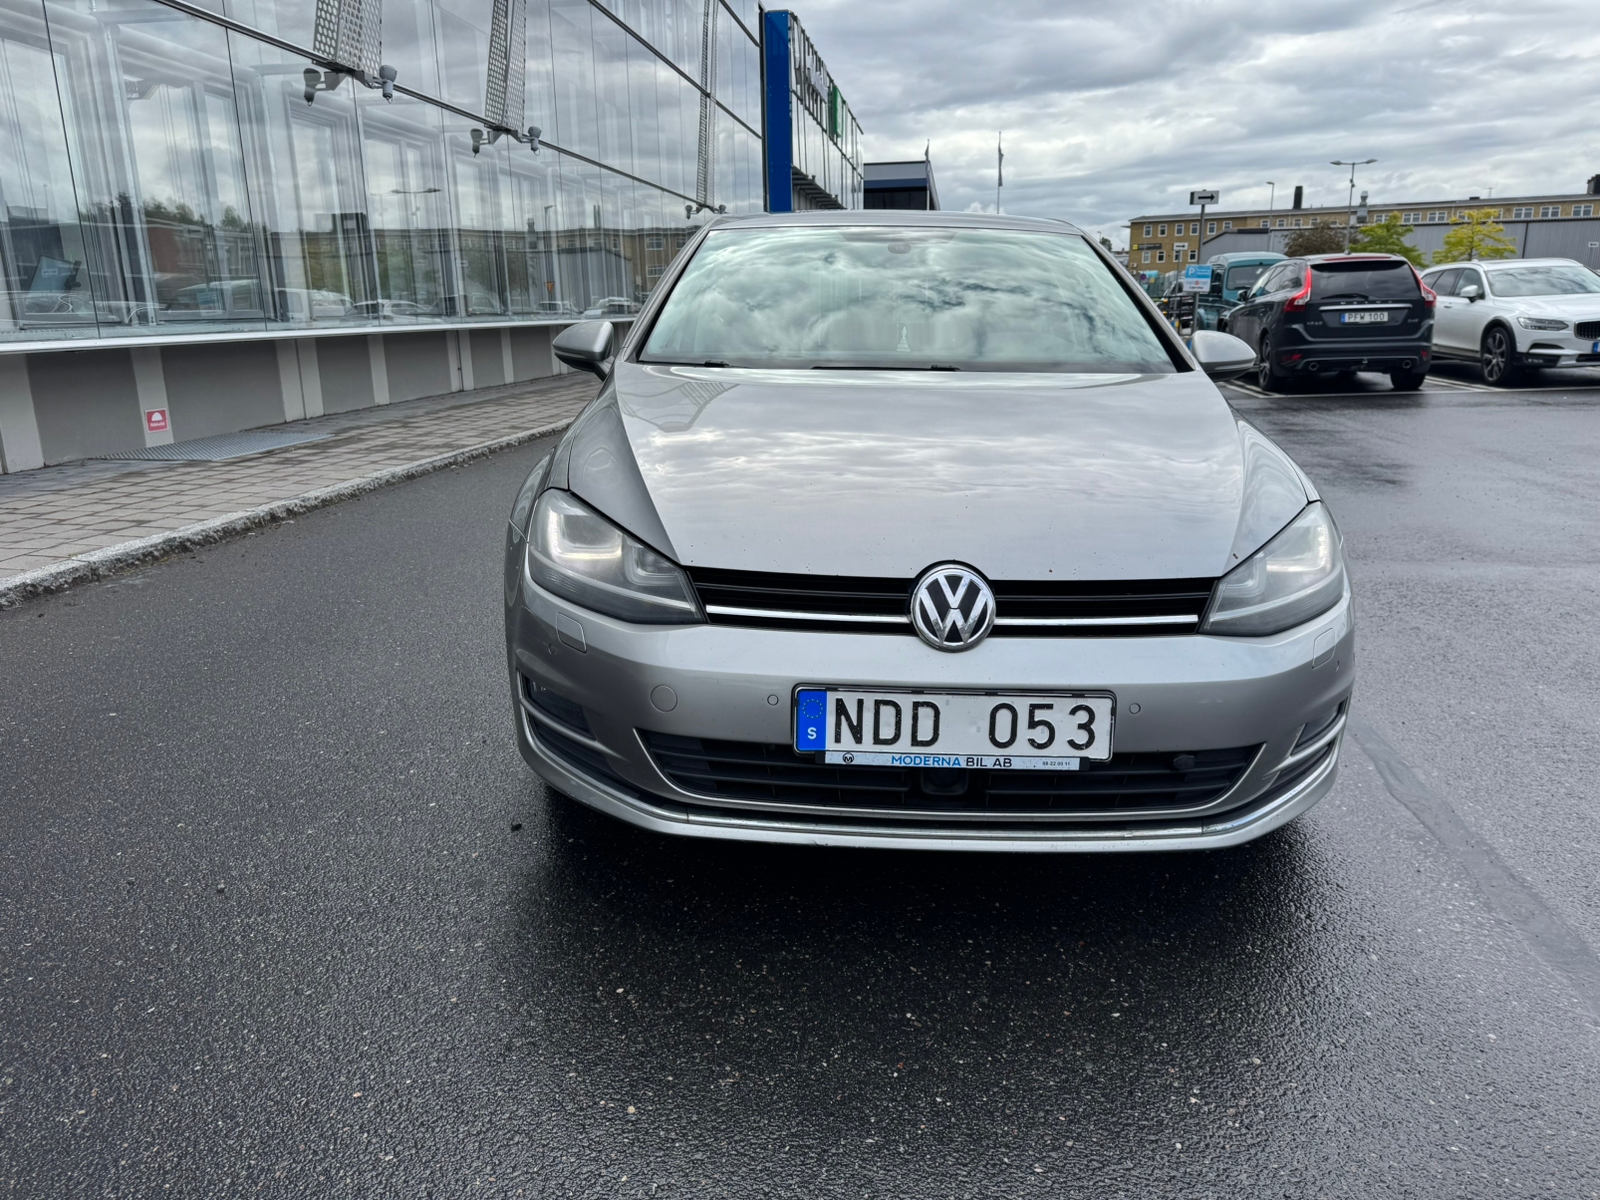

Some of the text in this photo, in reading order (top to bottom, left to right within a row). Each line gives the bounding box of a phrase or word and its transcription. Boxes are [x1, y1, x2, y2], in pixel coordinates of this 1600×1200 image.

[1348, 312, 1385, 321] PFW 100
[834, 698, 1096, 751] NDD 053
[807, 727, 818, 740] S
[891, 755, 1013, 768] MODERNA BIL AB
